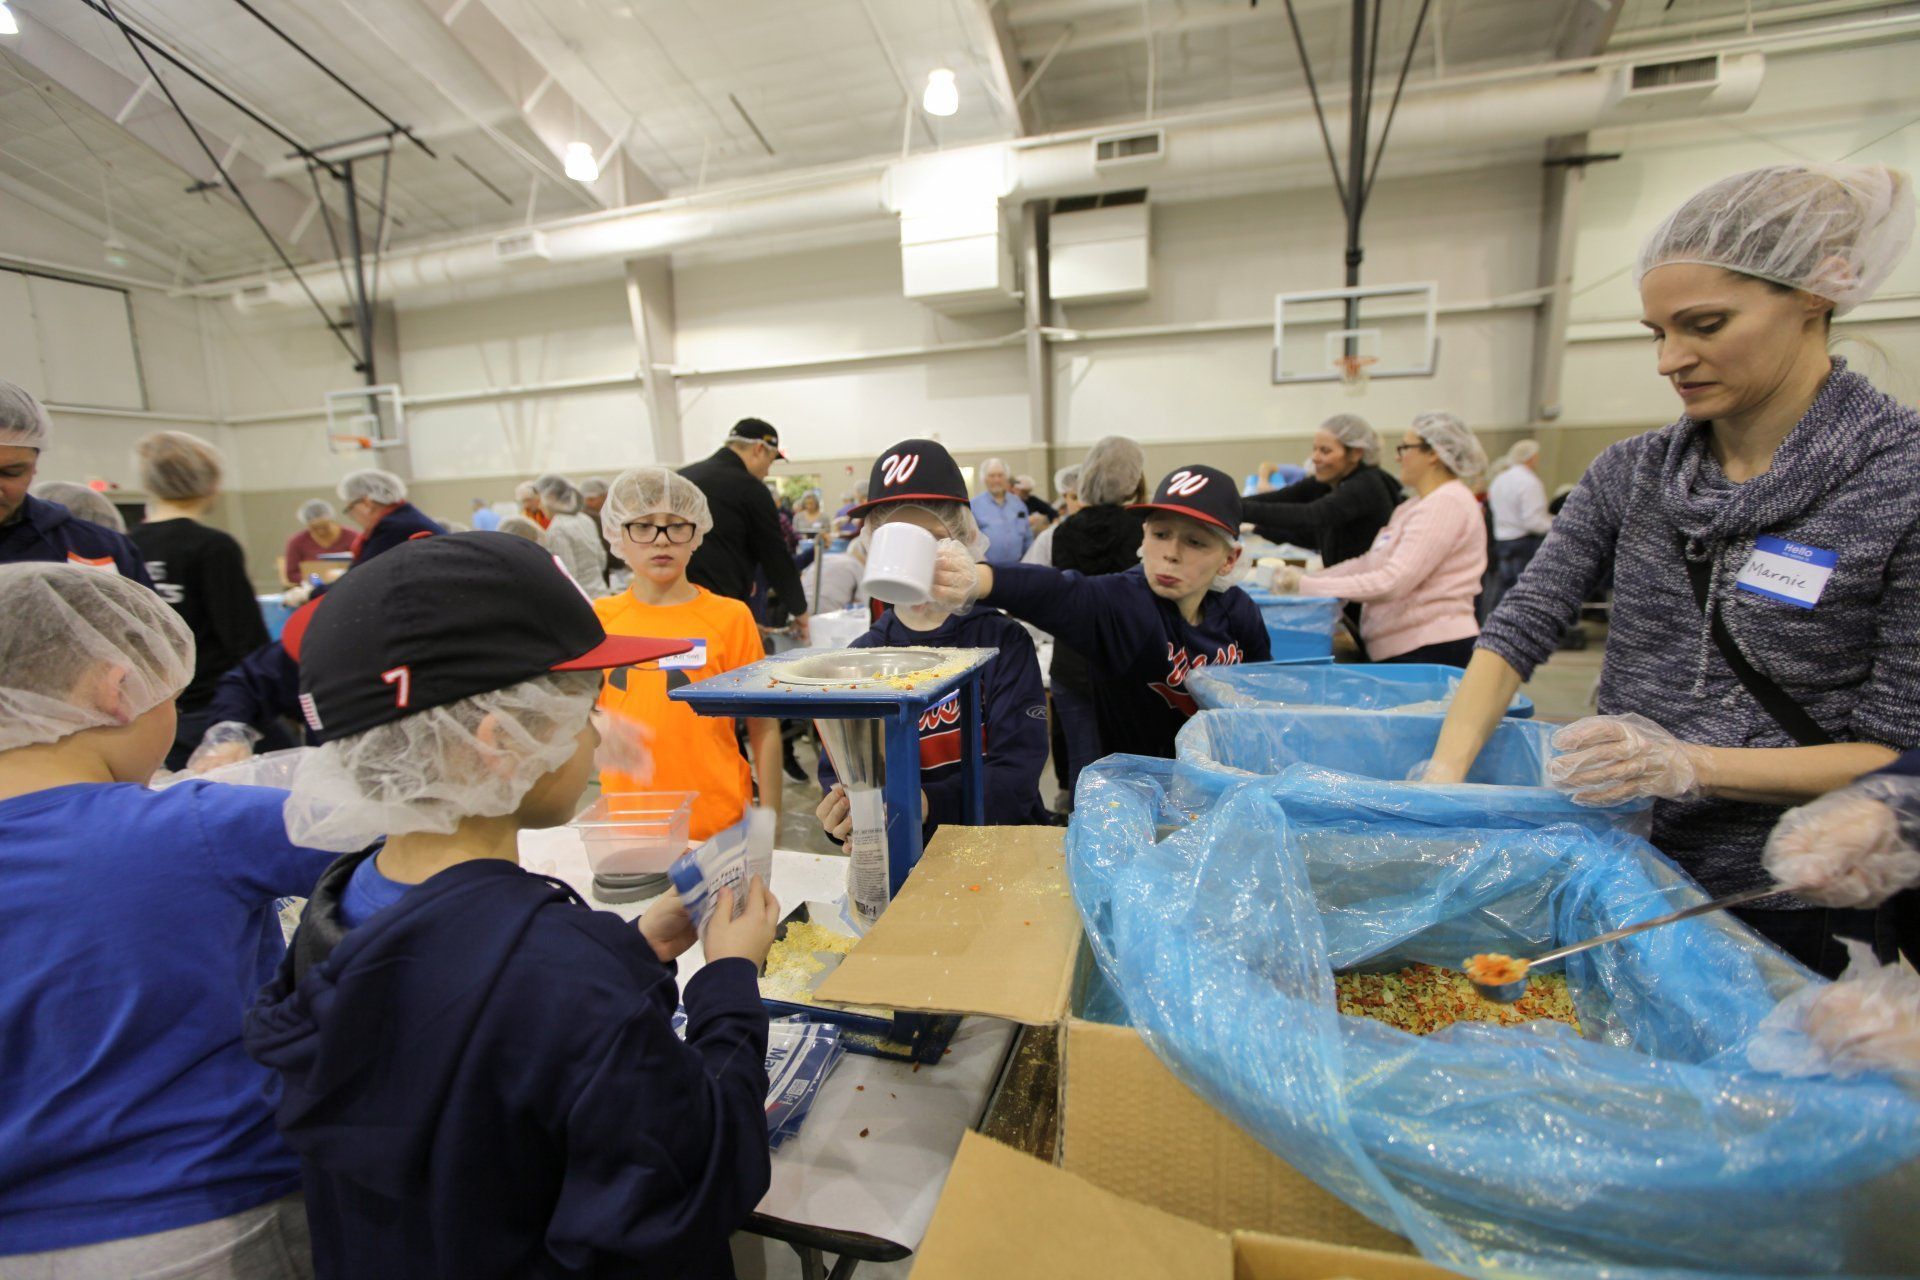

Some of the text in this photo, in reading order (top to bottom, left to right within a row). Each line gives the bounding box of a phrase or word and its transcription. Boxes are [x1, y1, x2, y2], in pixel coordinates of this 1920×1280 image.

[881, 453, 920, 488] W
[1166, 470, 1209, 497] W
[1783, 543, 1814, 557] Hello
[381, 665, 410, 708] 7
[764, 1047, 789, 1073] Ma
